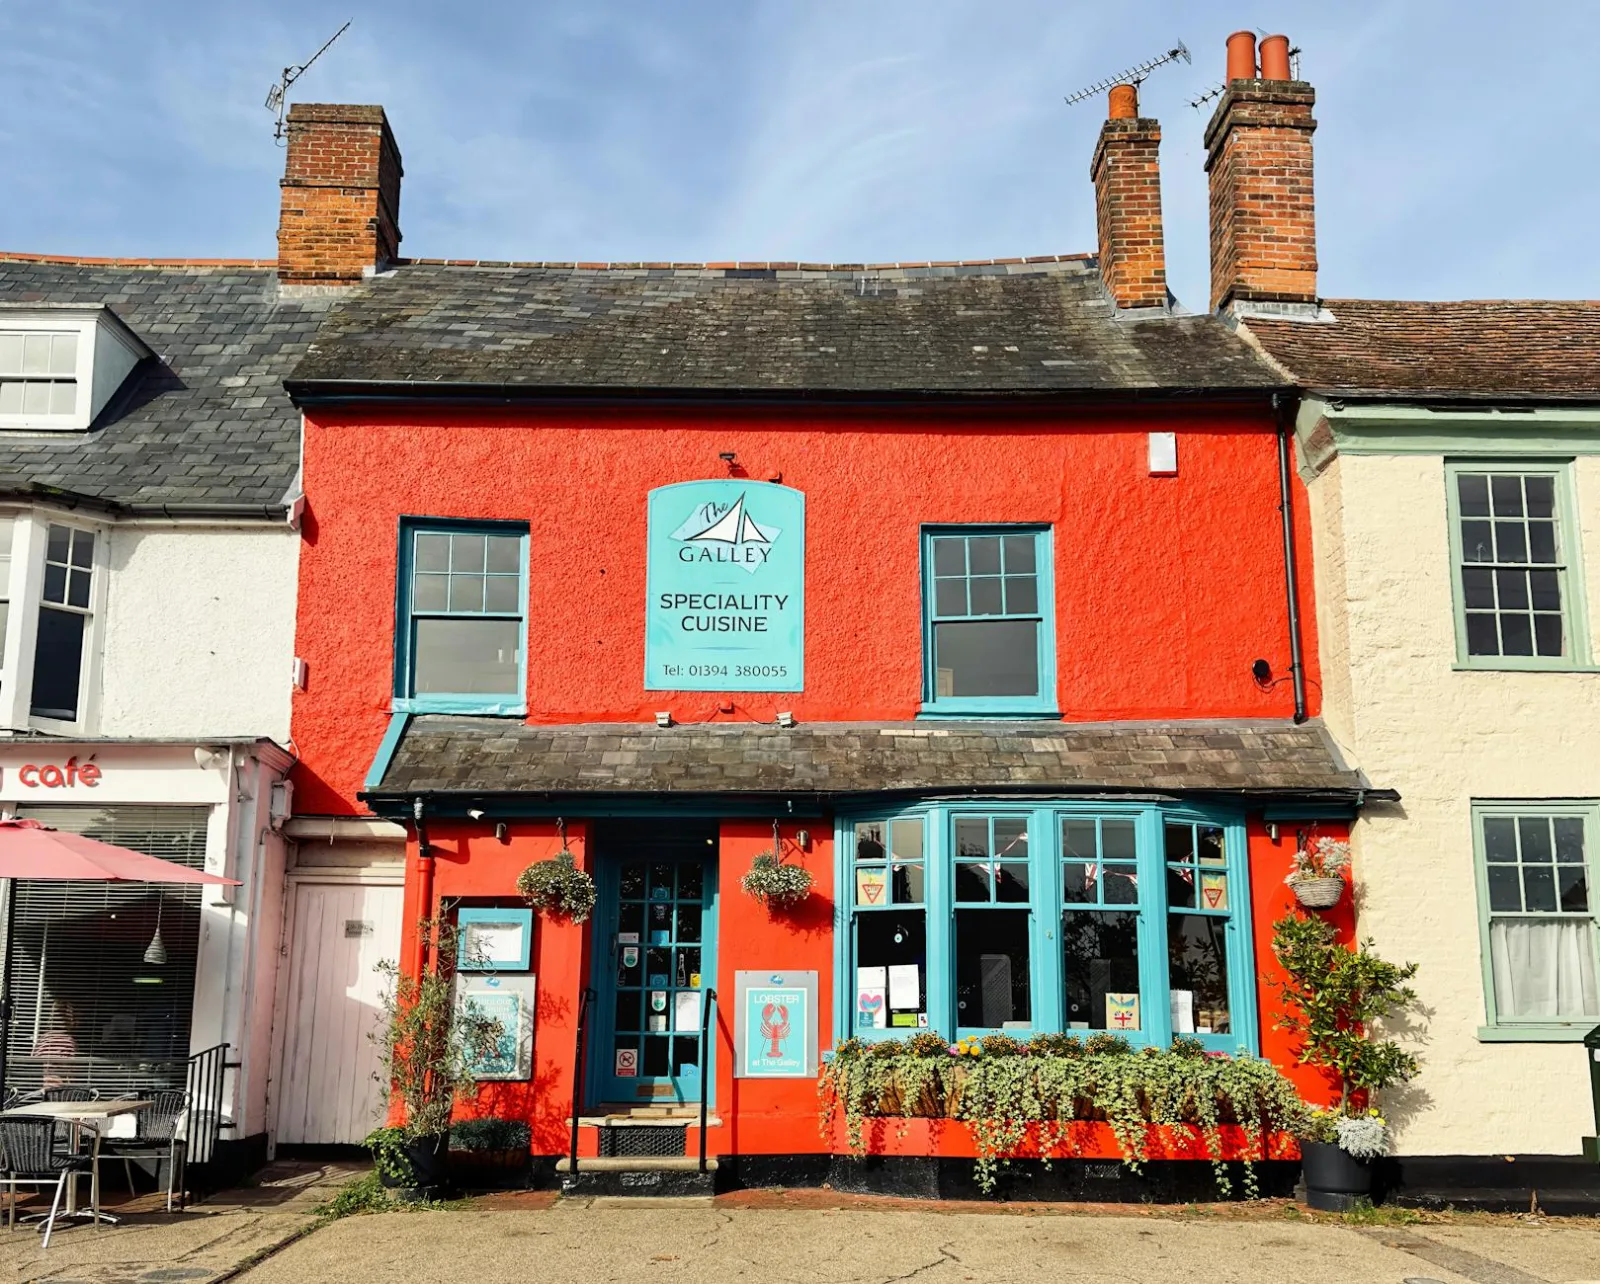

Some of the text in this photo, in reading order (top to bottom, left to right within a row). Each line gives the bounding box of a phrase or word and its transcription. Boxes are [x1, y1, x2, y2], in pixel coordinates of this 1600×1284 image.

[700, 501, 728, 524] The
[679, 546, 772, 563] GALLEY
[660, 593, 789, 610] SPECIALITY
[681, 615, 768, 632] CUISINE
[663, 664, 788, 677] Tel: 01394 380055
[18, 753, 102, 788] café
[754, 994, 799, 1004] LOBSTER
